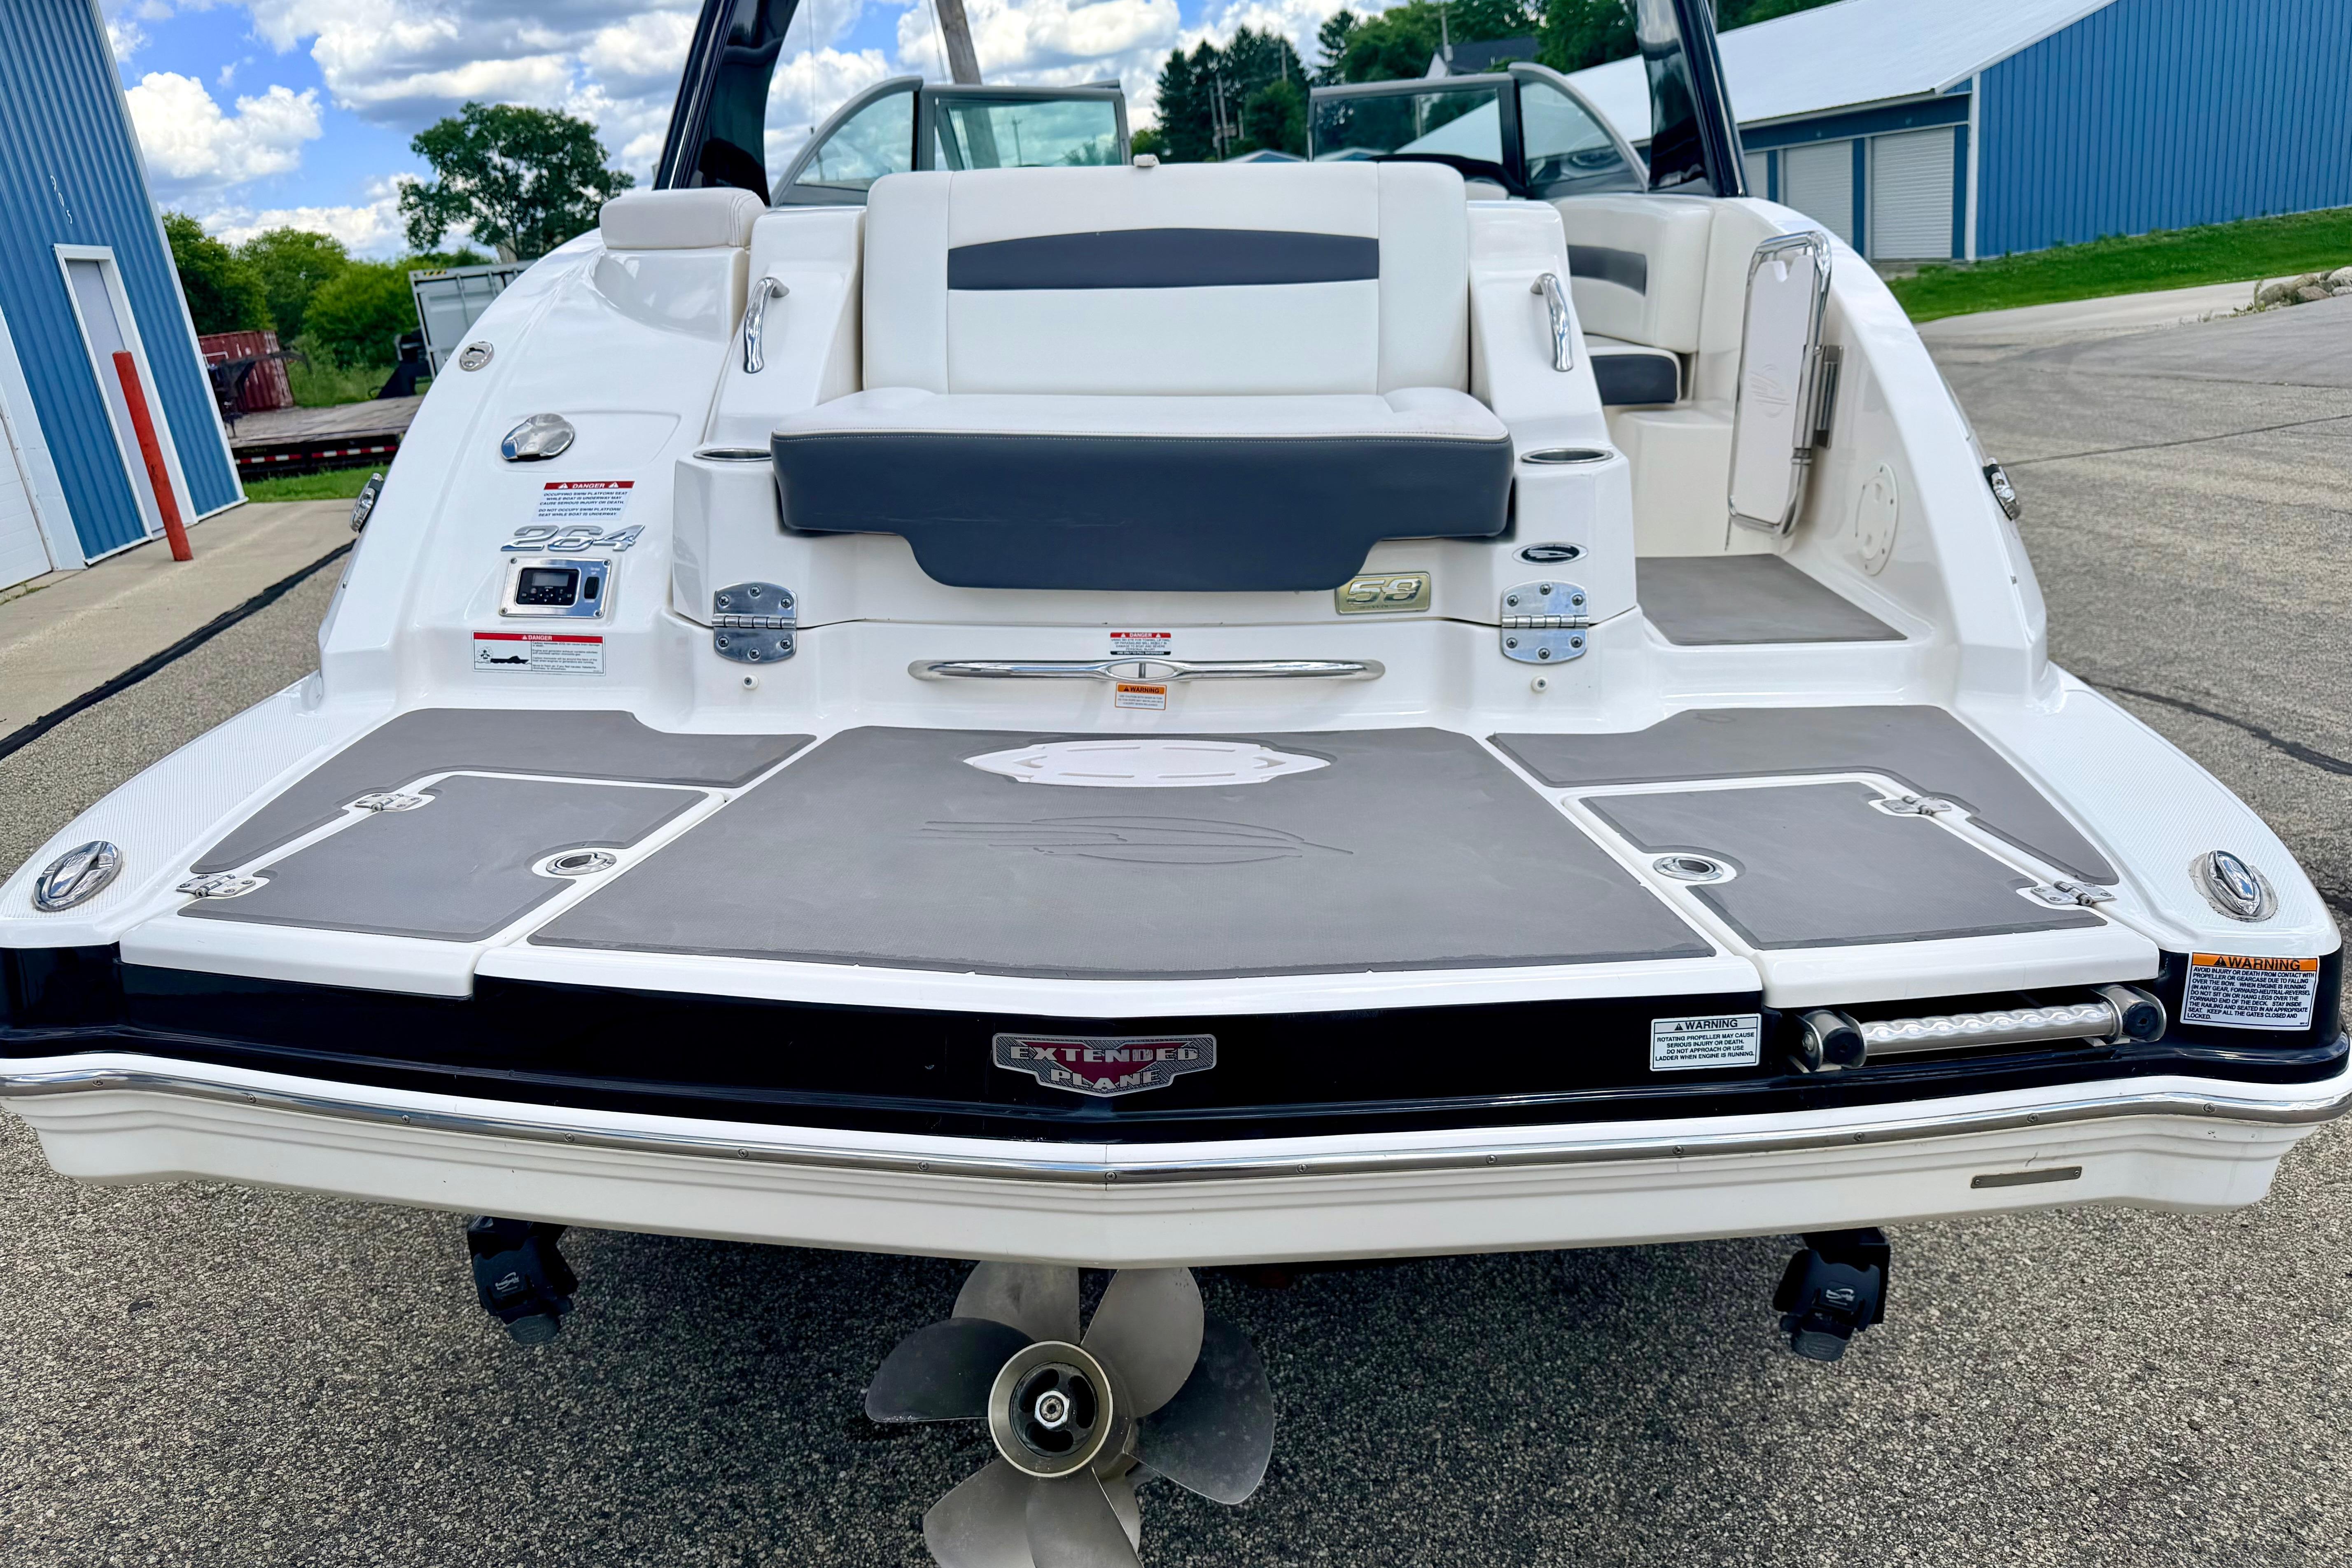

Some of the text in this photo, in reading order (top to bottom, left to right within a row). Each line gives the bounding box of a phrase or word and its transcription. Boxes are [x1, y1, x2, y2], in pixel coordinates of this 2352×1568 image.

[501, 525, 646, 551] 264
[2228, 957, 2300, 970] WARNING
[1685, 1020, 1738, 1030] WARNING
[1010, 1045, 1200, 1062] EXTENDED
[1050, 1069, 1161, 1089] PLANE
